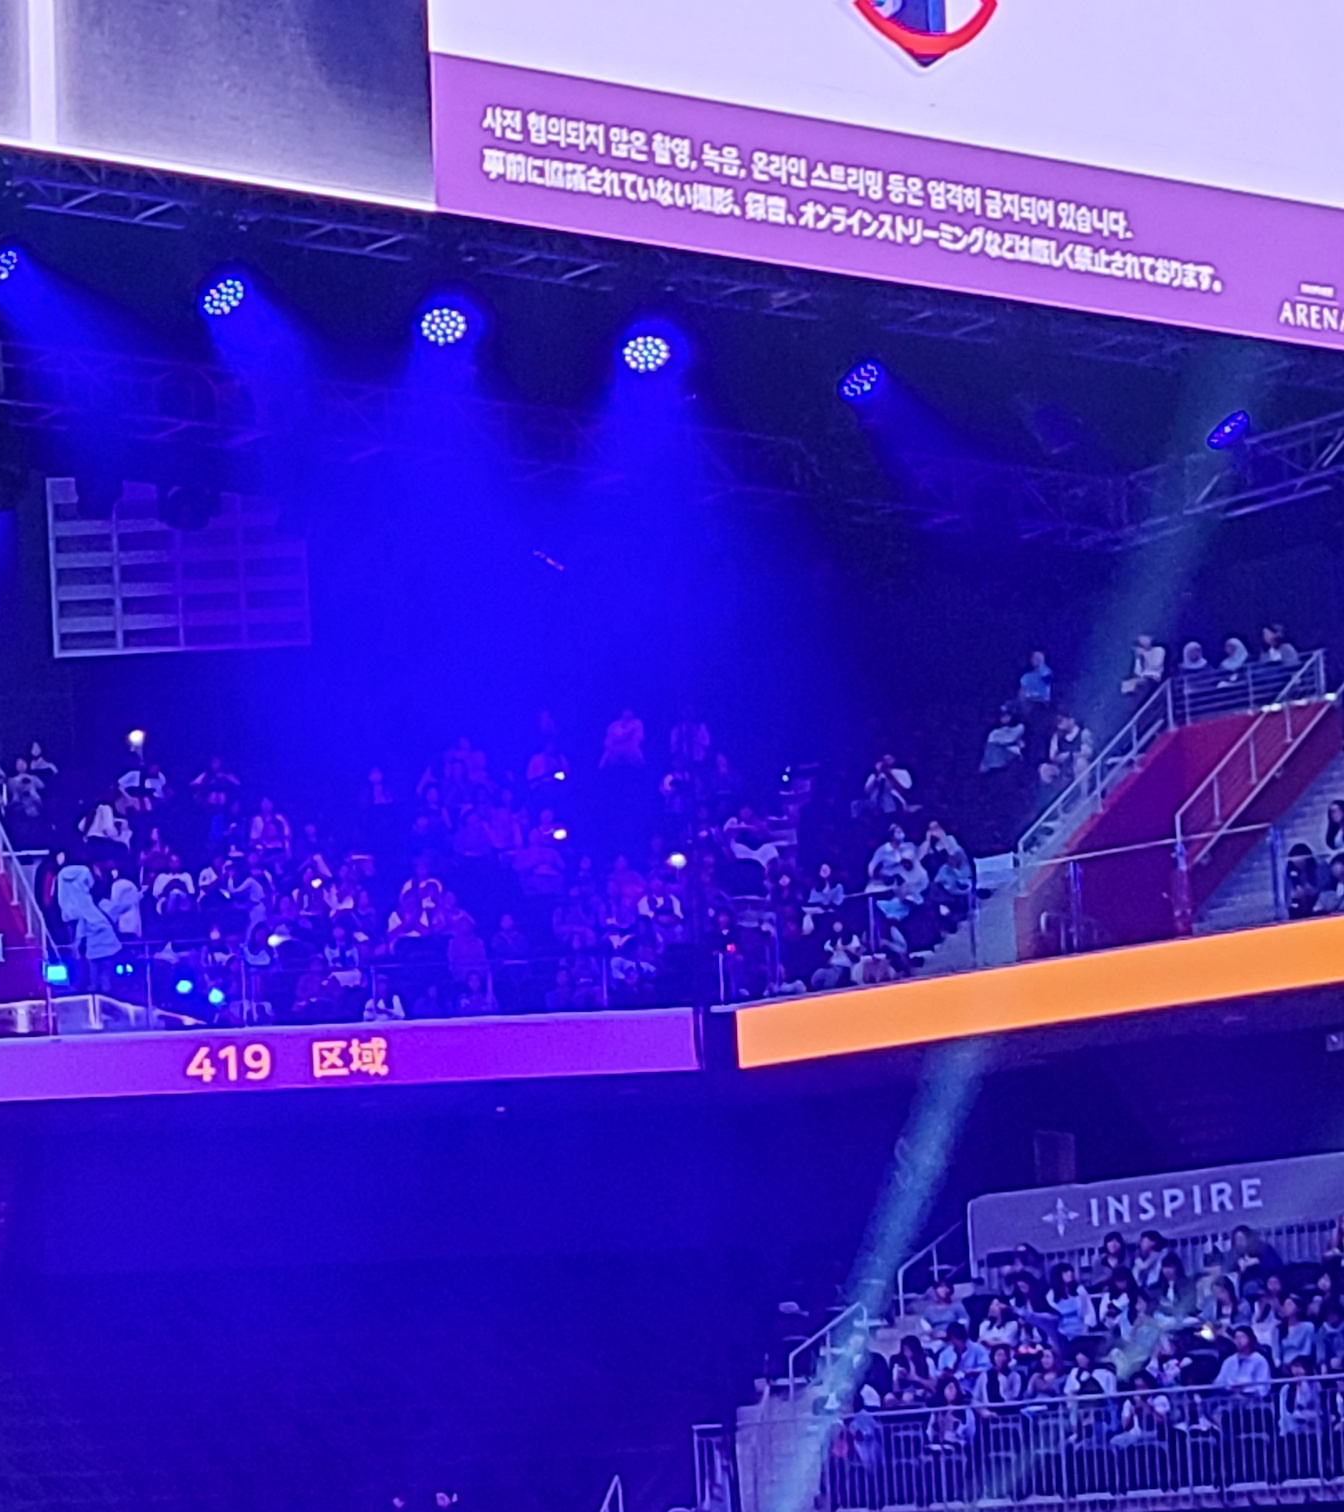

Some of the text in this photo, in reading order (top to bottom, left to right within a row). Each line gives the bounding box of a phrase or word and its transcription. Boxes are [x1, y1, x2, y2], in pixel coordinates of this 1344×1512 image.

[481, 105, 524, 142] 사전
[526, 111, 606, 155] 협의되지
[701, 141, 747, 179] 녹음,
[750, 150, 808, 188] 온라인
[811, 161, 883, 201] 스트리밍
[886, 173, 925, 207] 등은
[927, 180, 982, 216] 엄격히
[984, 188, 1056, 229] 금지되어
[1057, 202, 1134, 240] 있습니다.
[185, 1037, 390, 1083] 419 区域
[1089, 1177, 1264, 1227] INSPIRE
